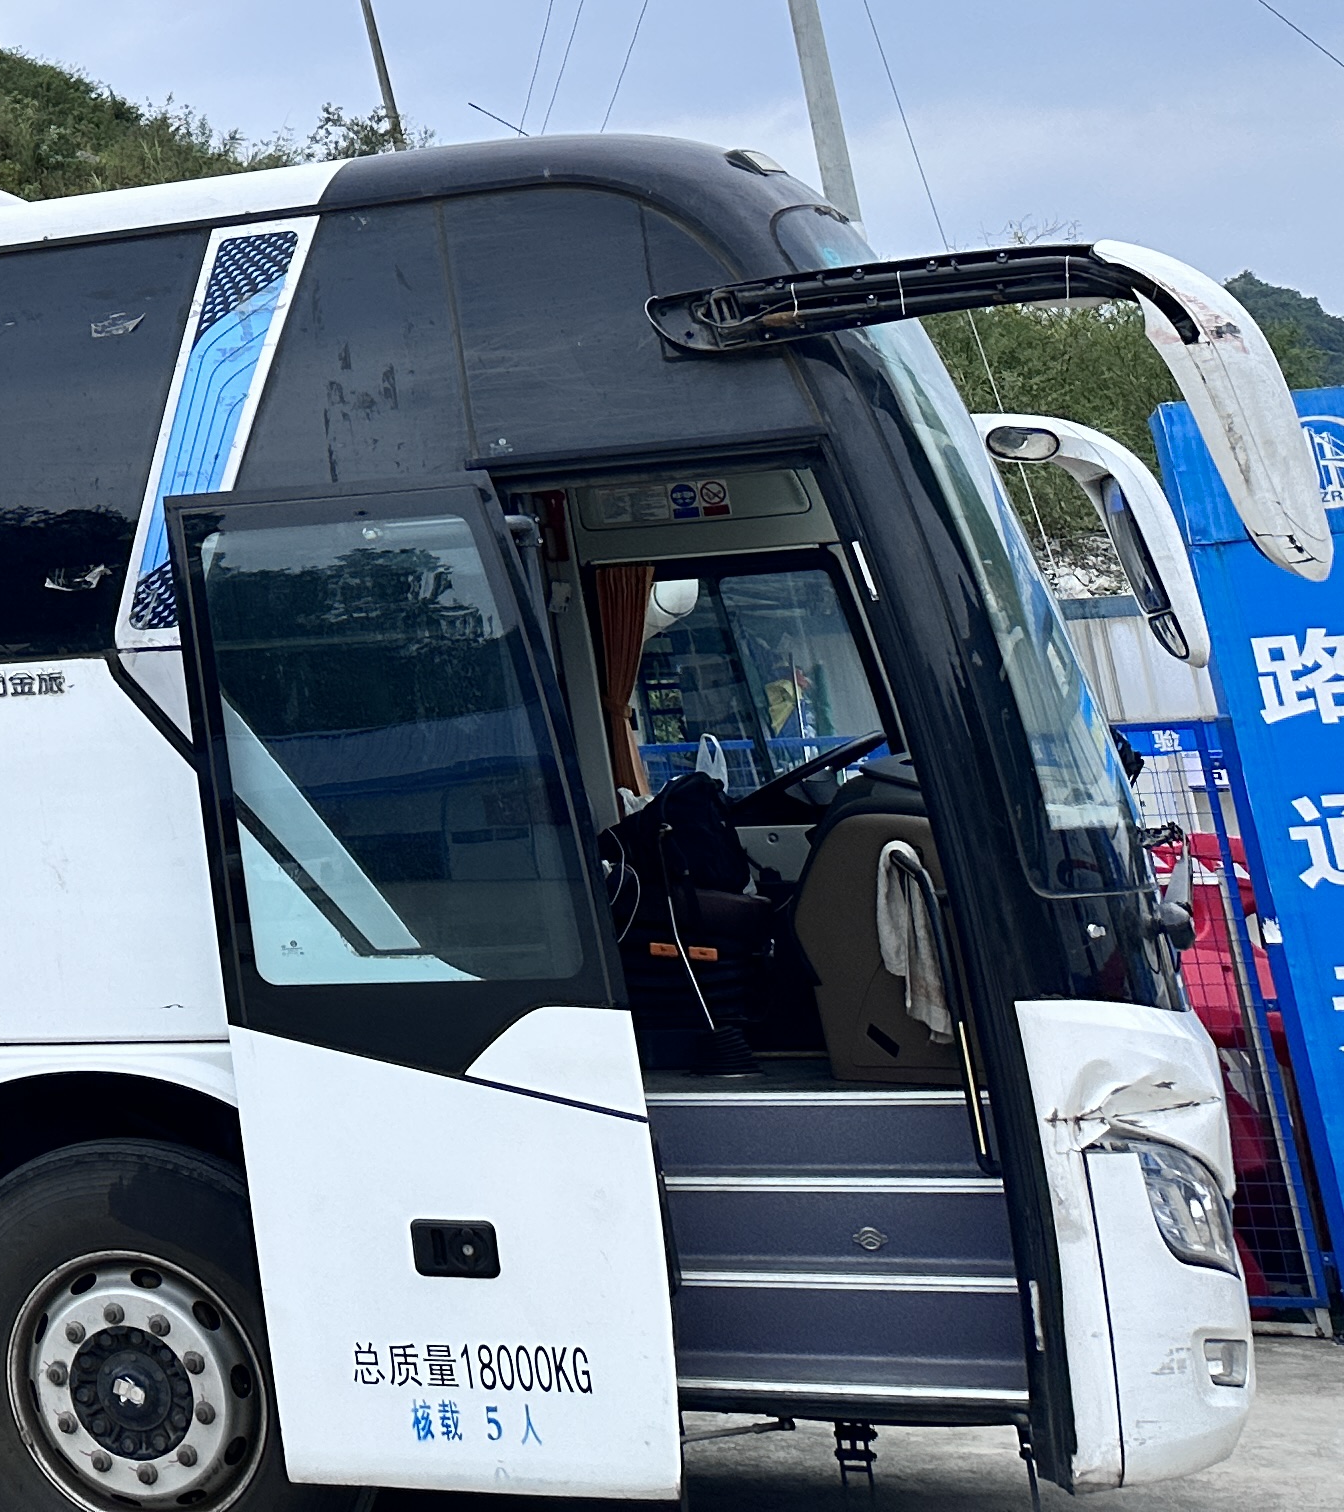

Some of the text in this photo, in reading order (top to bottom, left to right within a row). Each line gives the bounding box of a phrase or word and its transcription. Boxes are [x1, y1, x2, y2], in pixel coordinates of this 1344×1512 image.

[353, 1341, 593, 1394] 总质量18000KG
[410, 1399, 543, 1446] 核载 5 人
